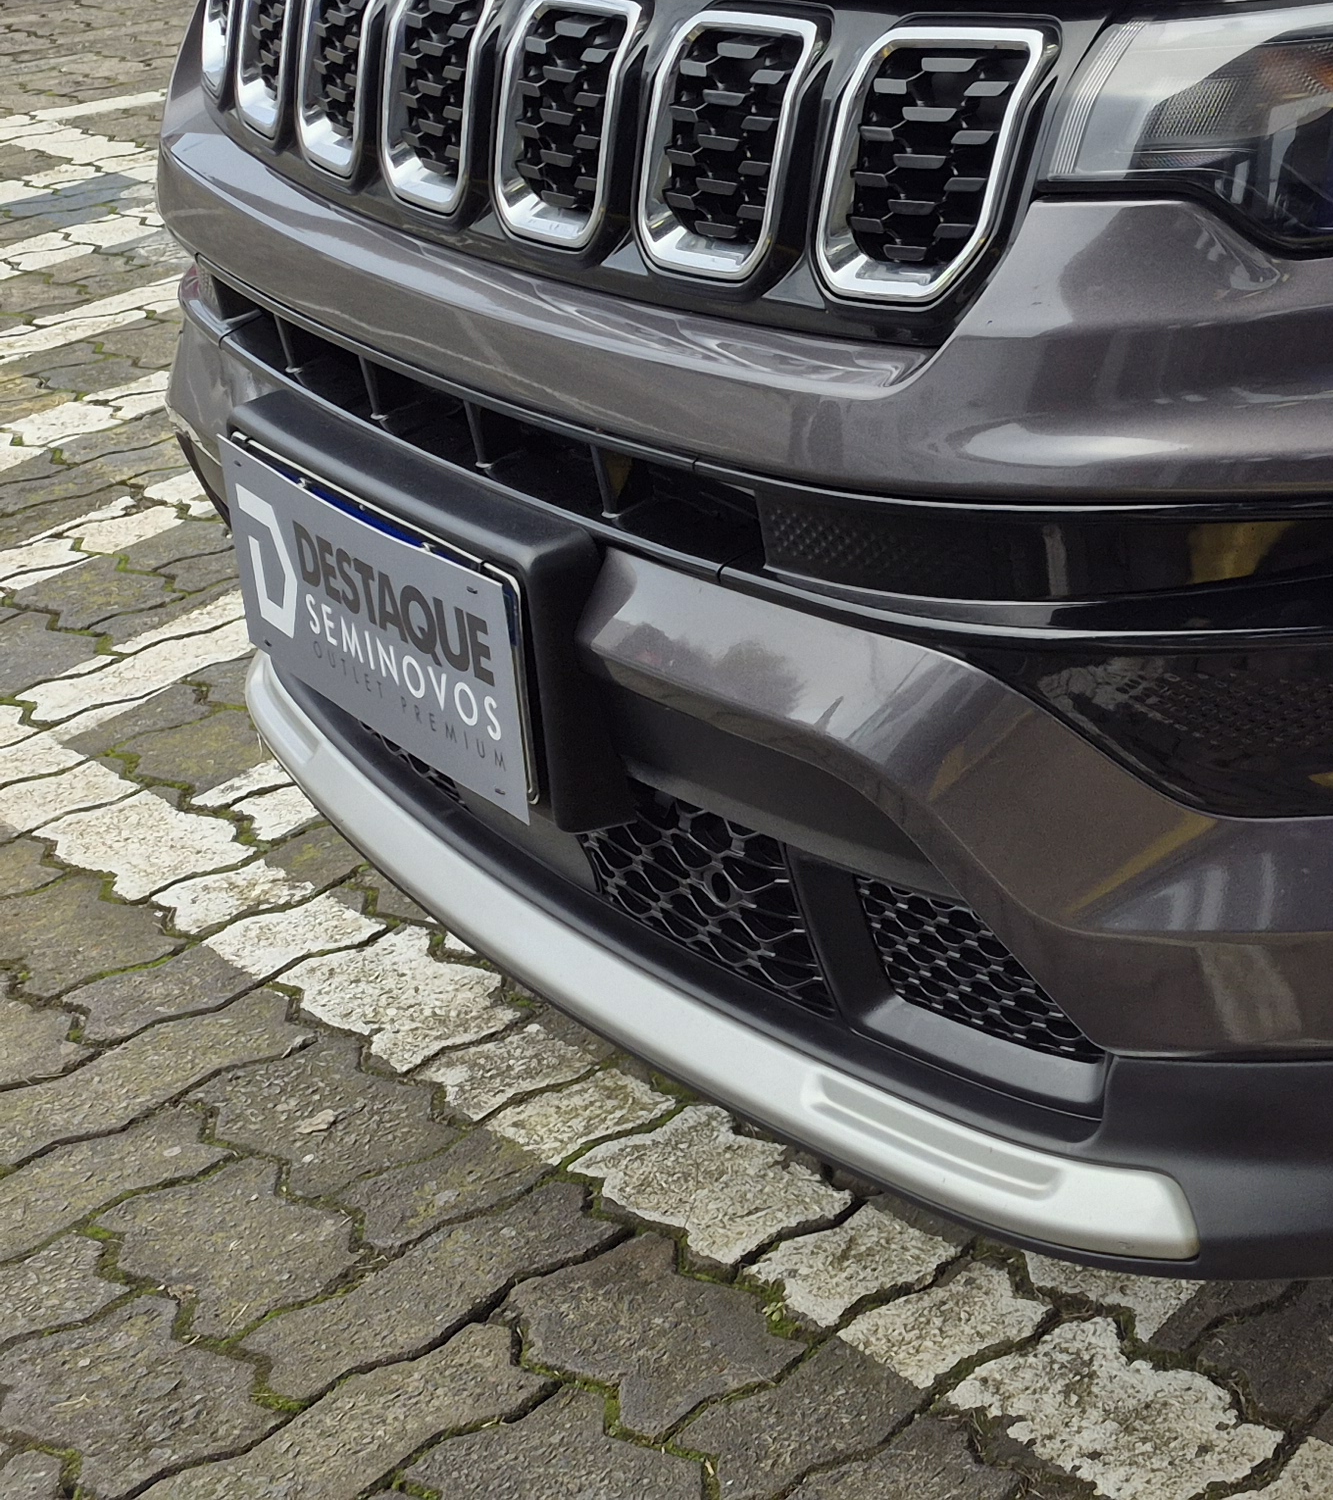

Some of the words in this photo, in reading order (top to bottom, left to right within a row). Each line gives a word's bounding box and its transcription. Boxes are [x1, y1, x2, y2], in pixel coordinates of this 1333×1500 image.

[292, 520, 495, 687] DESTAQUE
[305, 594, 503, 742] SEMINOVOS
[312, 640, 384, 699] OUTLET
[401, 696, 508, 773] PREMIUM
